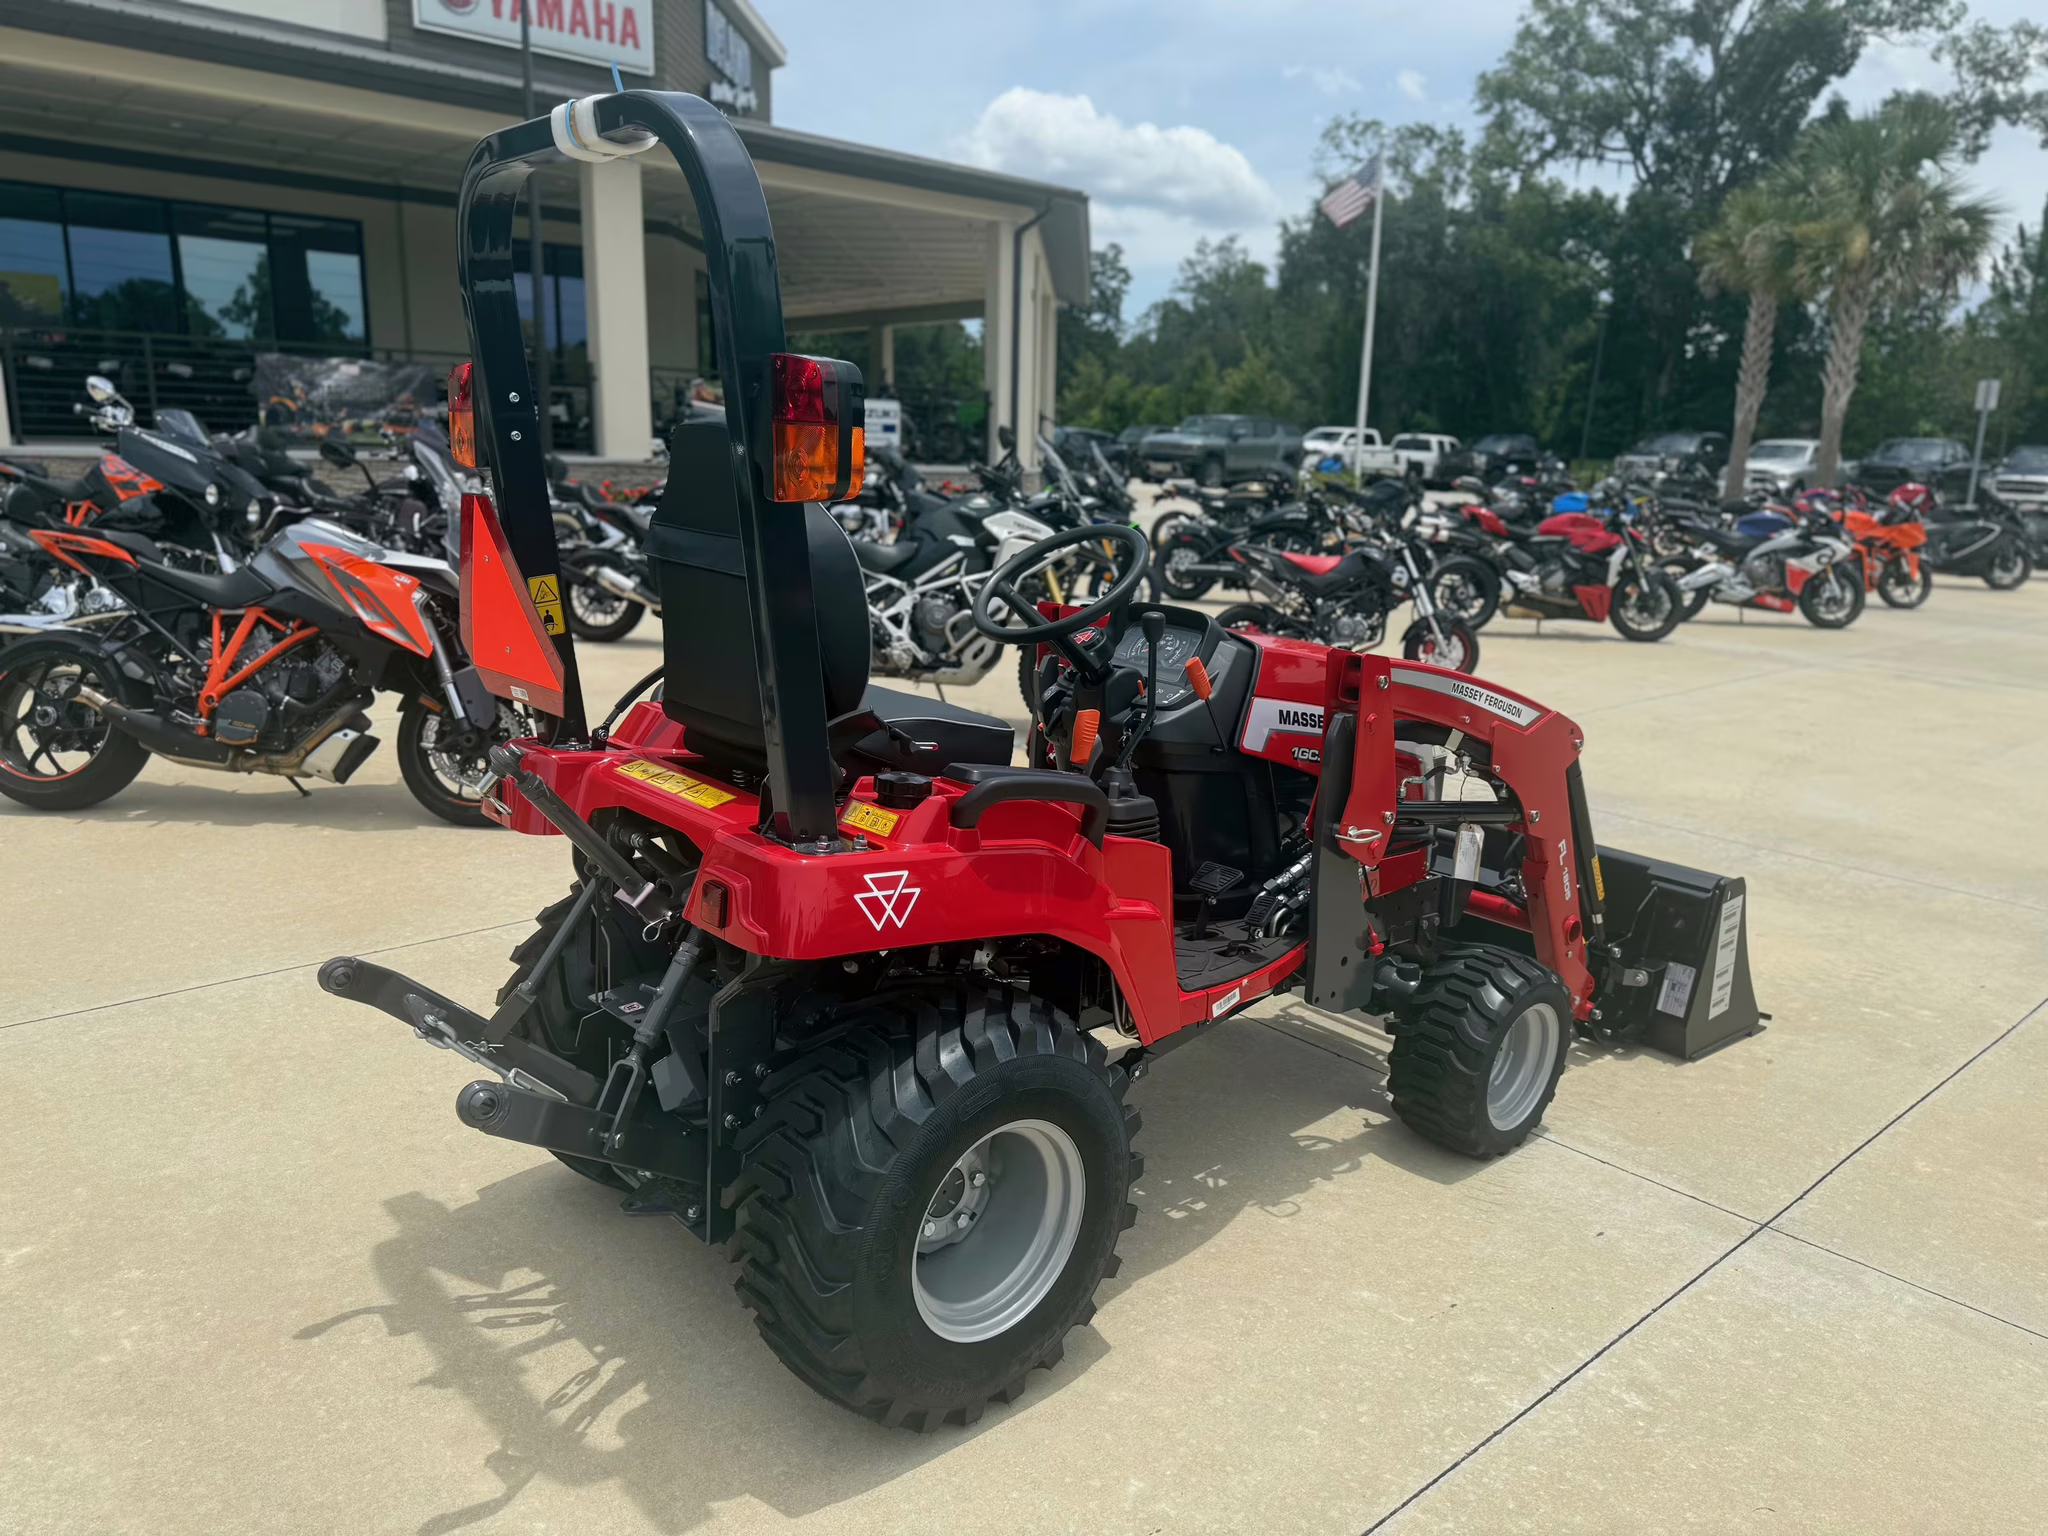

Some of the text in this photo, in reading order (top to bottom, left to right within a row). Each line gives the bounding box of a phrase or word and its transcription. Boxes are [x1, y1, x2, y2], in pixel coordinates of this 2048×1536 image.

[1451, 682, 1523, 719] MASSEY FERGUSON
[1279, 709, 1324, 729] MASSE
[1292, 746, 1321, 762] 1GC
[1557, 838, 1567, 866] FL
